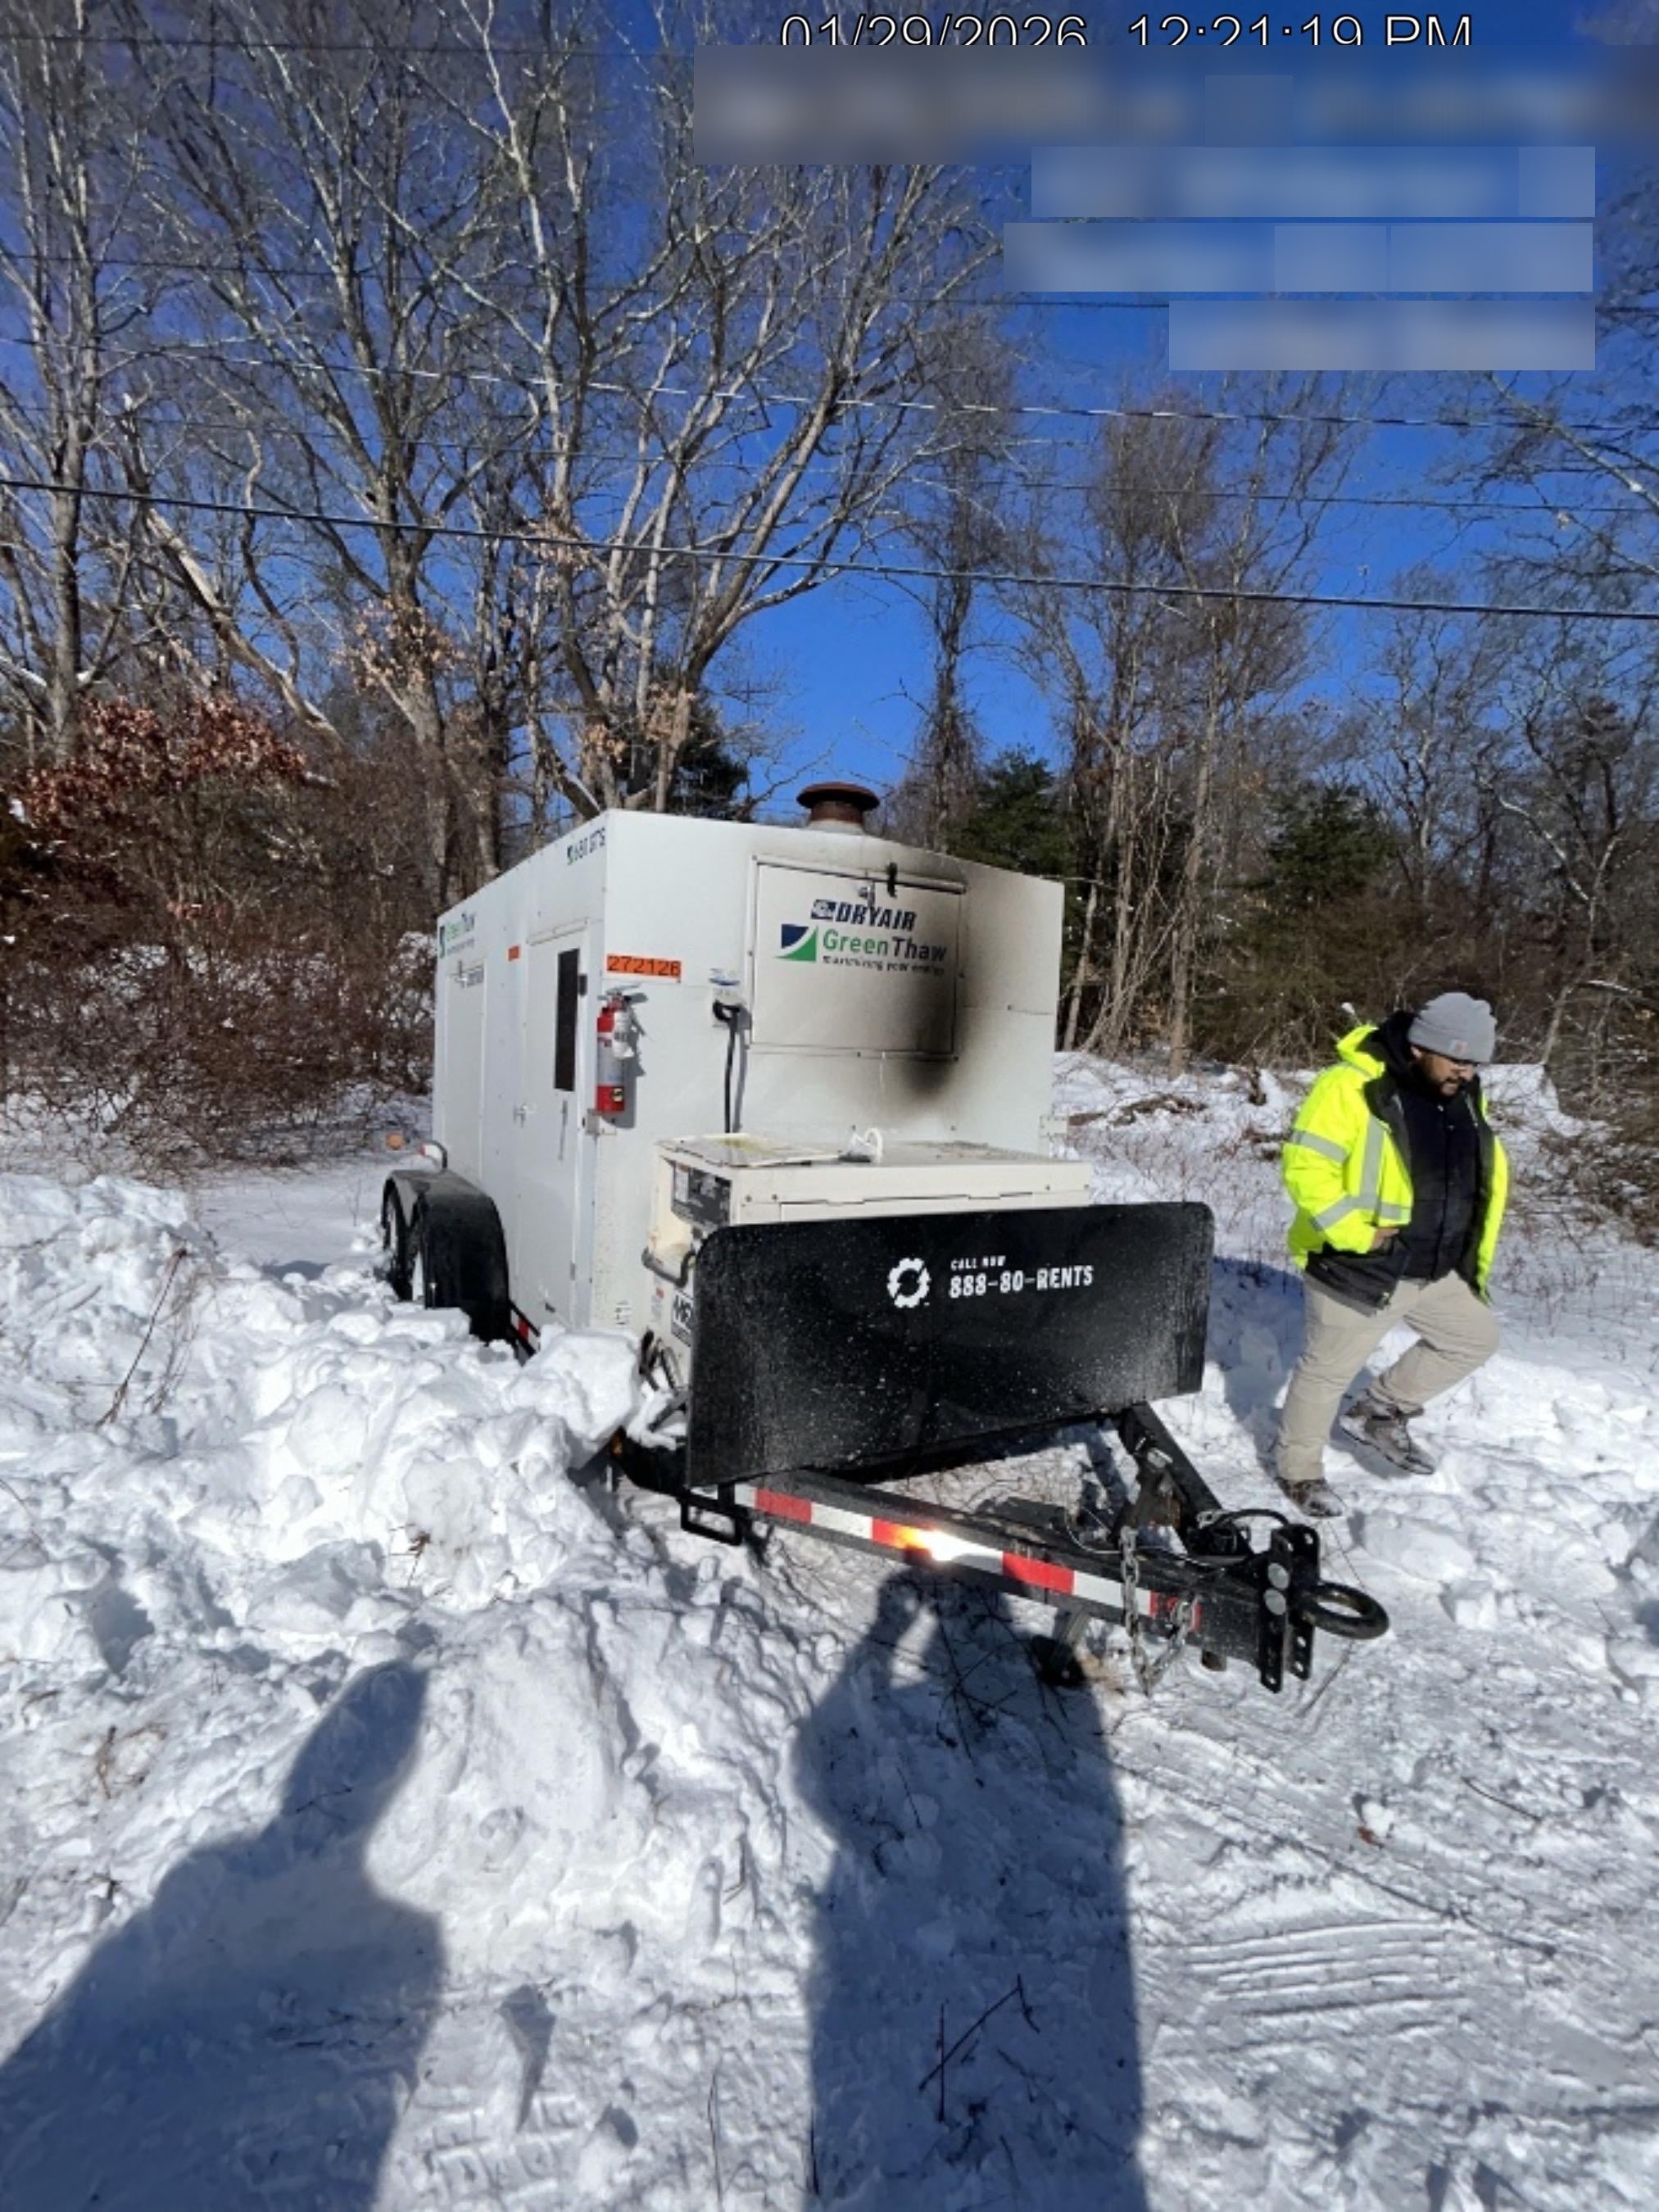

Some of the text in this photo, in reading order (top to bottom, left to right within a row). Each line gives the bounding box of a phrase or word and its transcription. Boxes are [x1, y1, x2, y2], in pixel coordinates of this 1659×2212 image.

[836, 902, 917, 931] DRYAIR
[607, 955, 681, 977] 272126
[948, 1265, 1095, 1299] 888-80-RENTS
